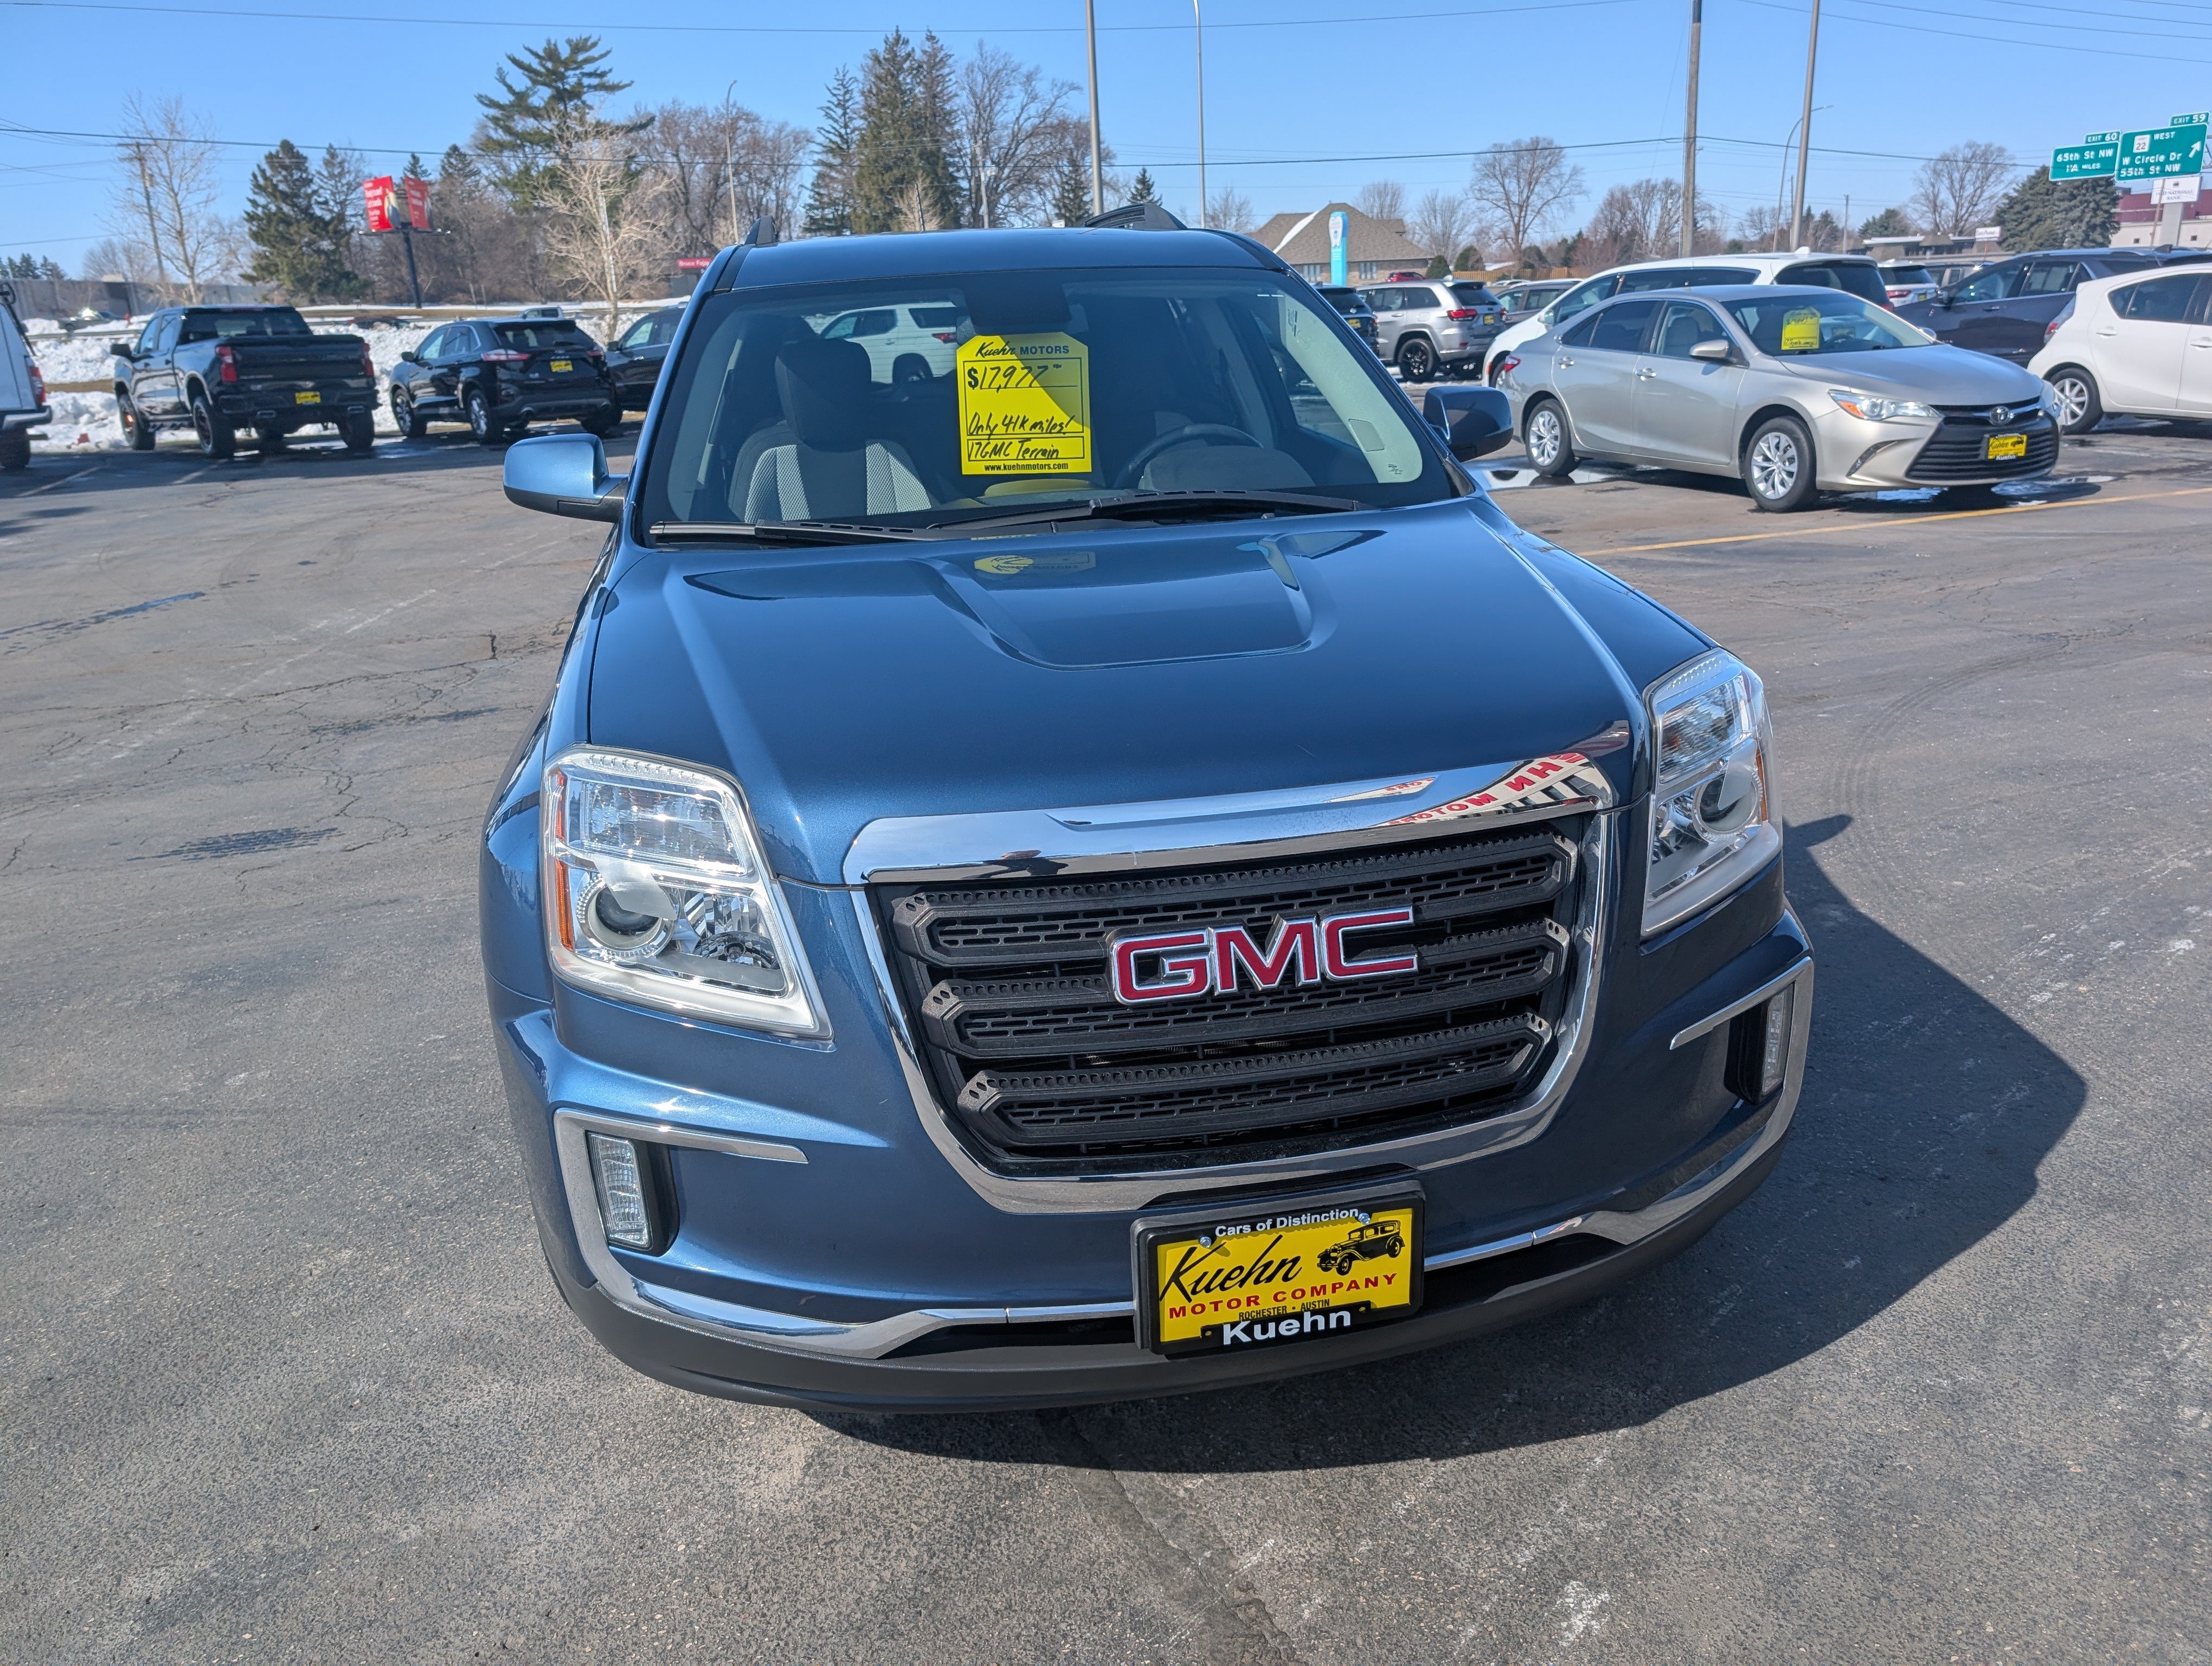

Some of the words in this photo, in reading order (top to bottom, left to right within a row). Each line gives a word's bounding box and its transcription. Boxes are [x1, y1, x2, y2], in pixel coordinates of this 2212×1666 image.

[2173, 116, 2190, 124] EXIT
[2192, 114, 2205, 124] 59
[2105, 133, 2117, 141] 60
[2153, 131, 2176, 140] WEST
[2136, 142, 2146, 150] 22
[2056, 152, 2080, 162] 65th
[2084, 151, 2095, 160] St
[2099, 148, 2114, 158] NW
[2122, 157, 2131, 166] W
[2134, 153, 2165, 164] Circle
[2169, 152, 2183, 162] Dr
[2120, 167, 2145, 177] 55th
[2149, 166, 2161, 175] St
[2164, 163, 2182, 173] NW
[975, 341, 1016, 358] Kuehn
[1020, 345, 1070, 355] MOTORS
[968, 412, 999, 440] Only
[984, 463, 1069, 471] www.kuehnmotors.com
[1110, 905, 1419, 1005] GMC
[1215, 1222, 1252, 1238] Cars
[1256, 1218, 1272, 1232] of
[1276, 1207, 1359, 1230] Distinction
[1159, 1234, 1303, 1304] Kuehn
[1168, 1294, 1261, 1319] MOTOR
[1272, 1272, 1398, 1303] COMPANY
[1238, 1305, 1288, 1322] ROCHESTER
[1301, 1298, 1330, 1312] AUSTIN
[1223, 1309, 1352, 1346] Kuehn
